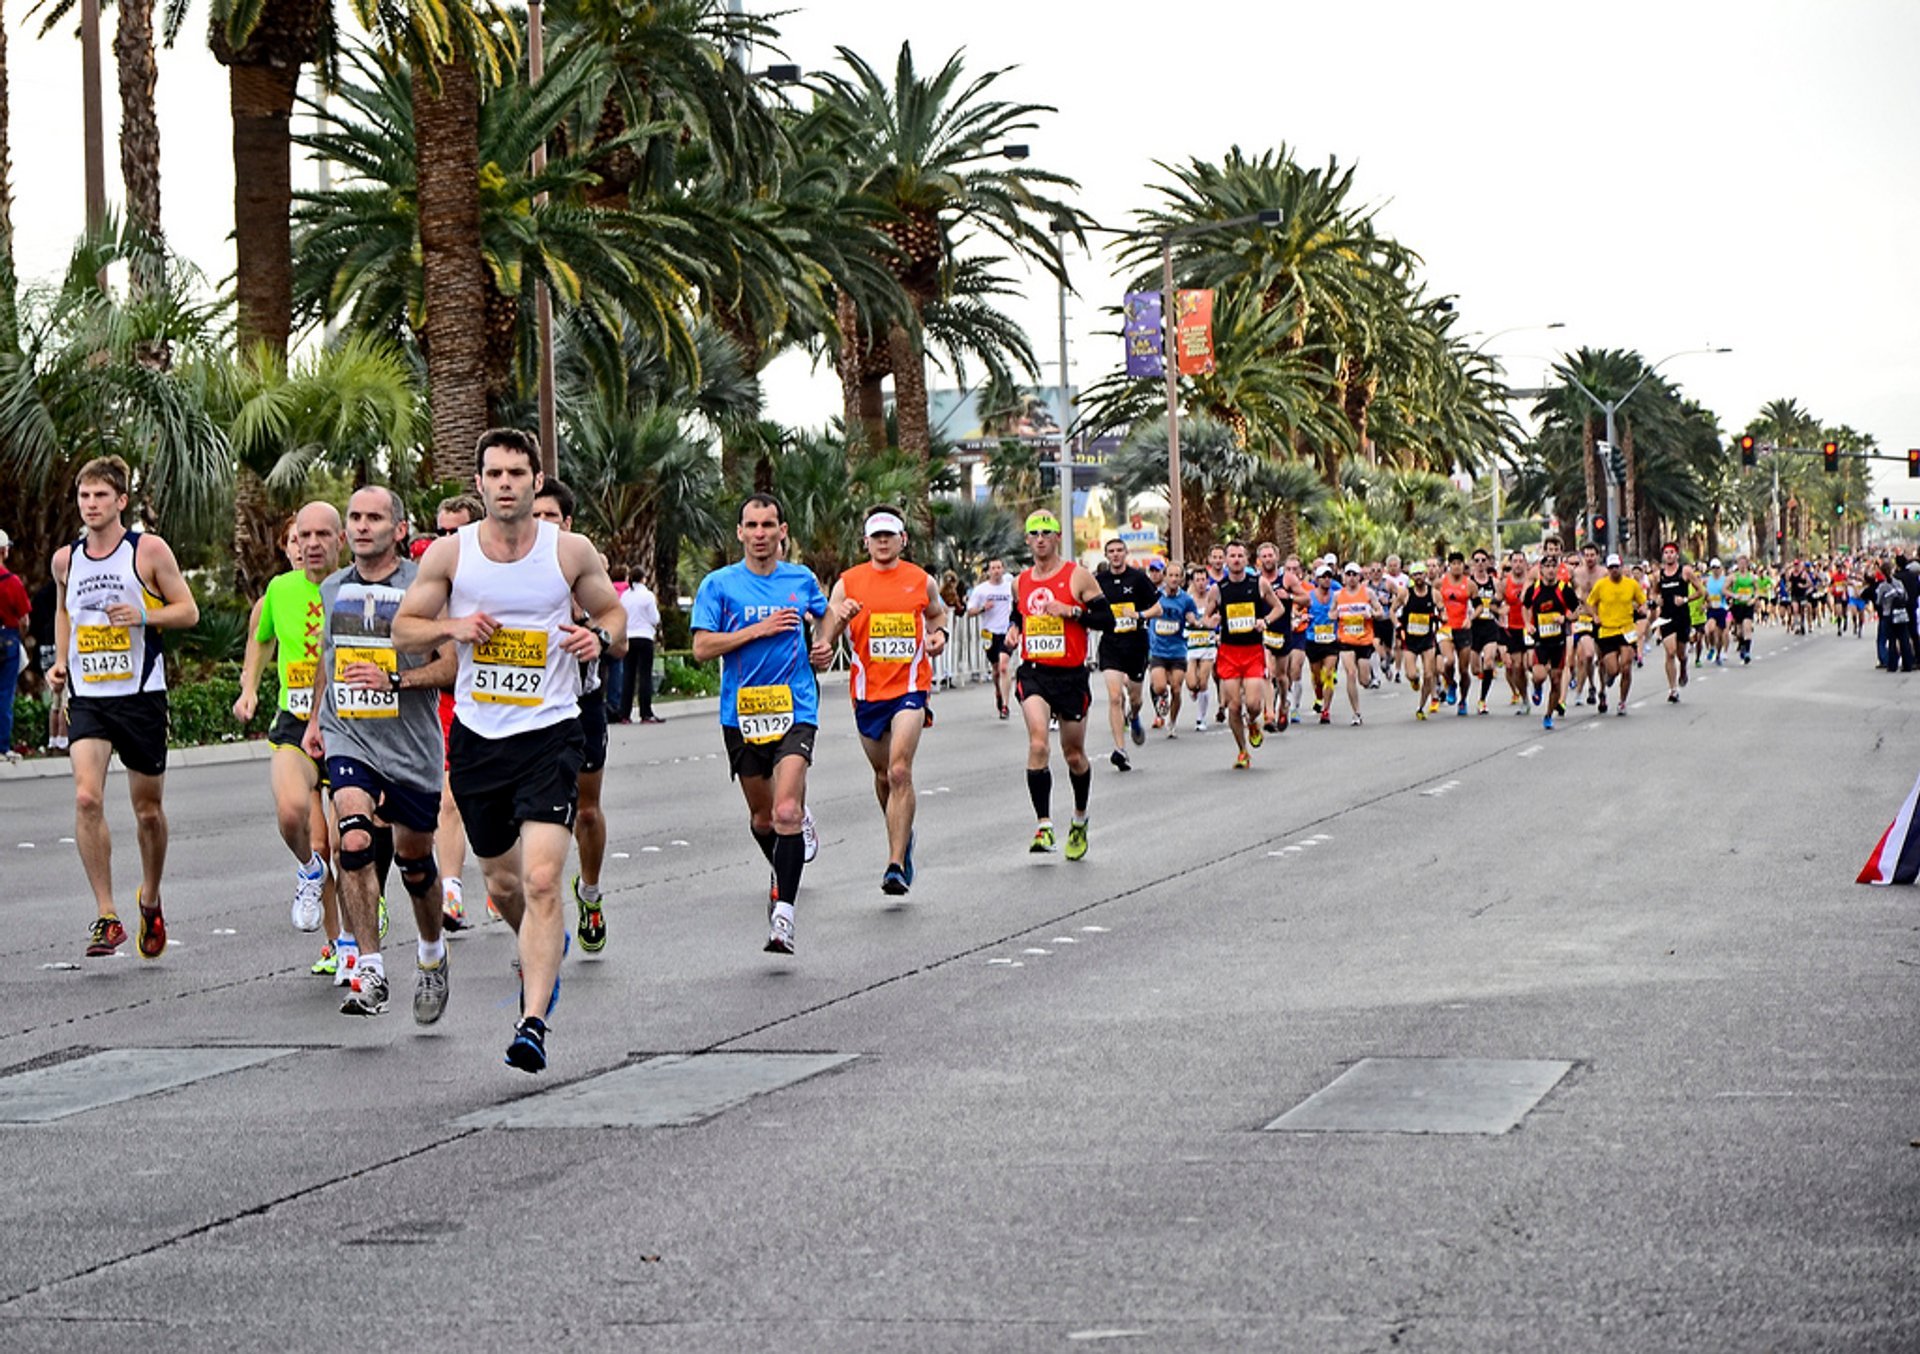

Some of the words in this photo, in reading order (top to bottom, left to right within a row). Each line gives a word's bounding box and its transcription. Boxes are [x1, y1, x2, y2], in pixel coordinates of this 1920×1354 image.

[872, 641, 914, 654] 51236
[1027, 638, 1062, 651] 51067
[478, 645, 499, 657] LAS
[502, 648, 543, 660] VEGAS
[82, 655, 129, 673] 51473
[475, 669, 541, 692] 51429
[739, 702, 755, 710] LAS
[758, 700, 789, 709] VEGAS
[743, 716, 790, 734] 51129
